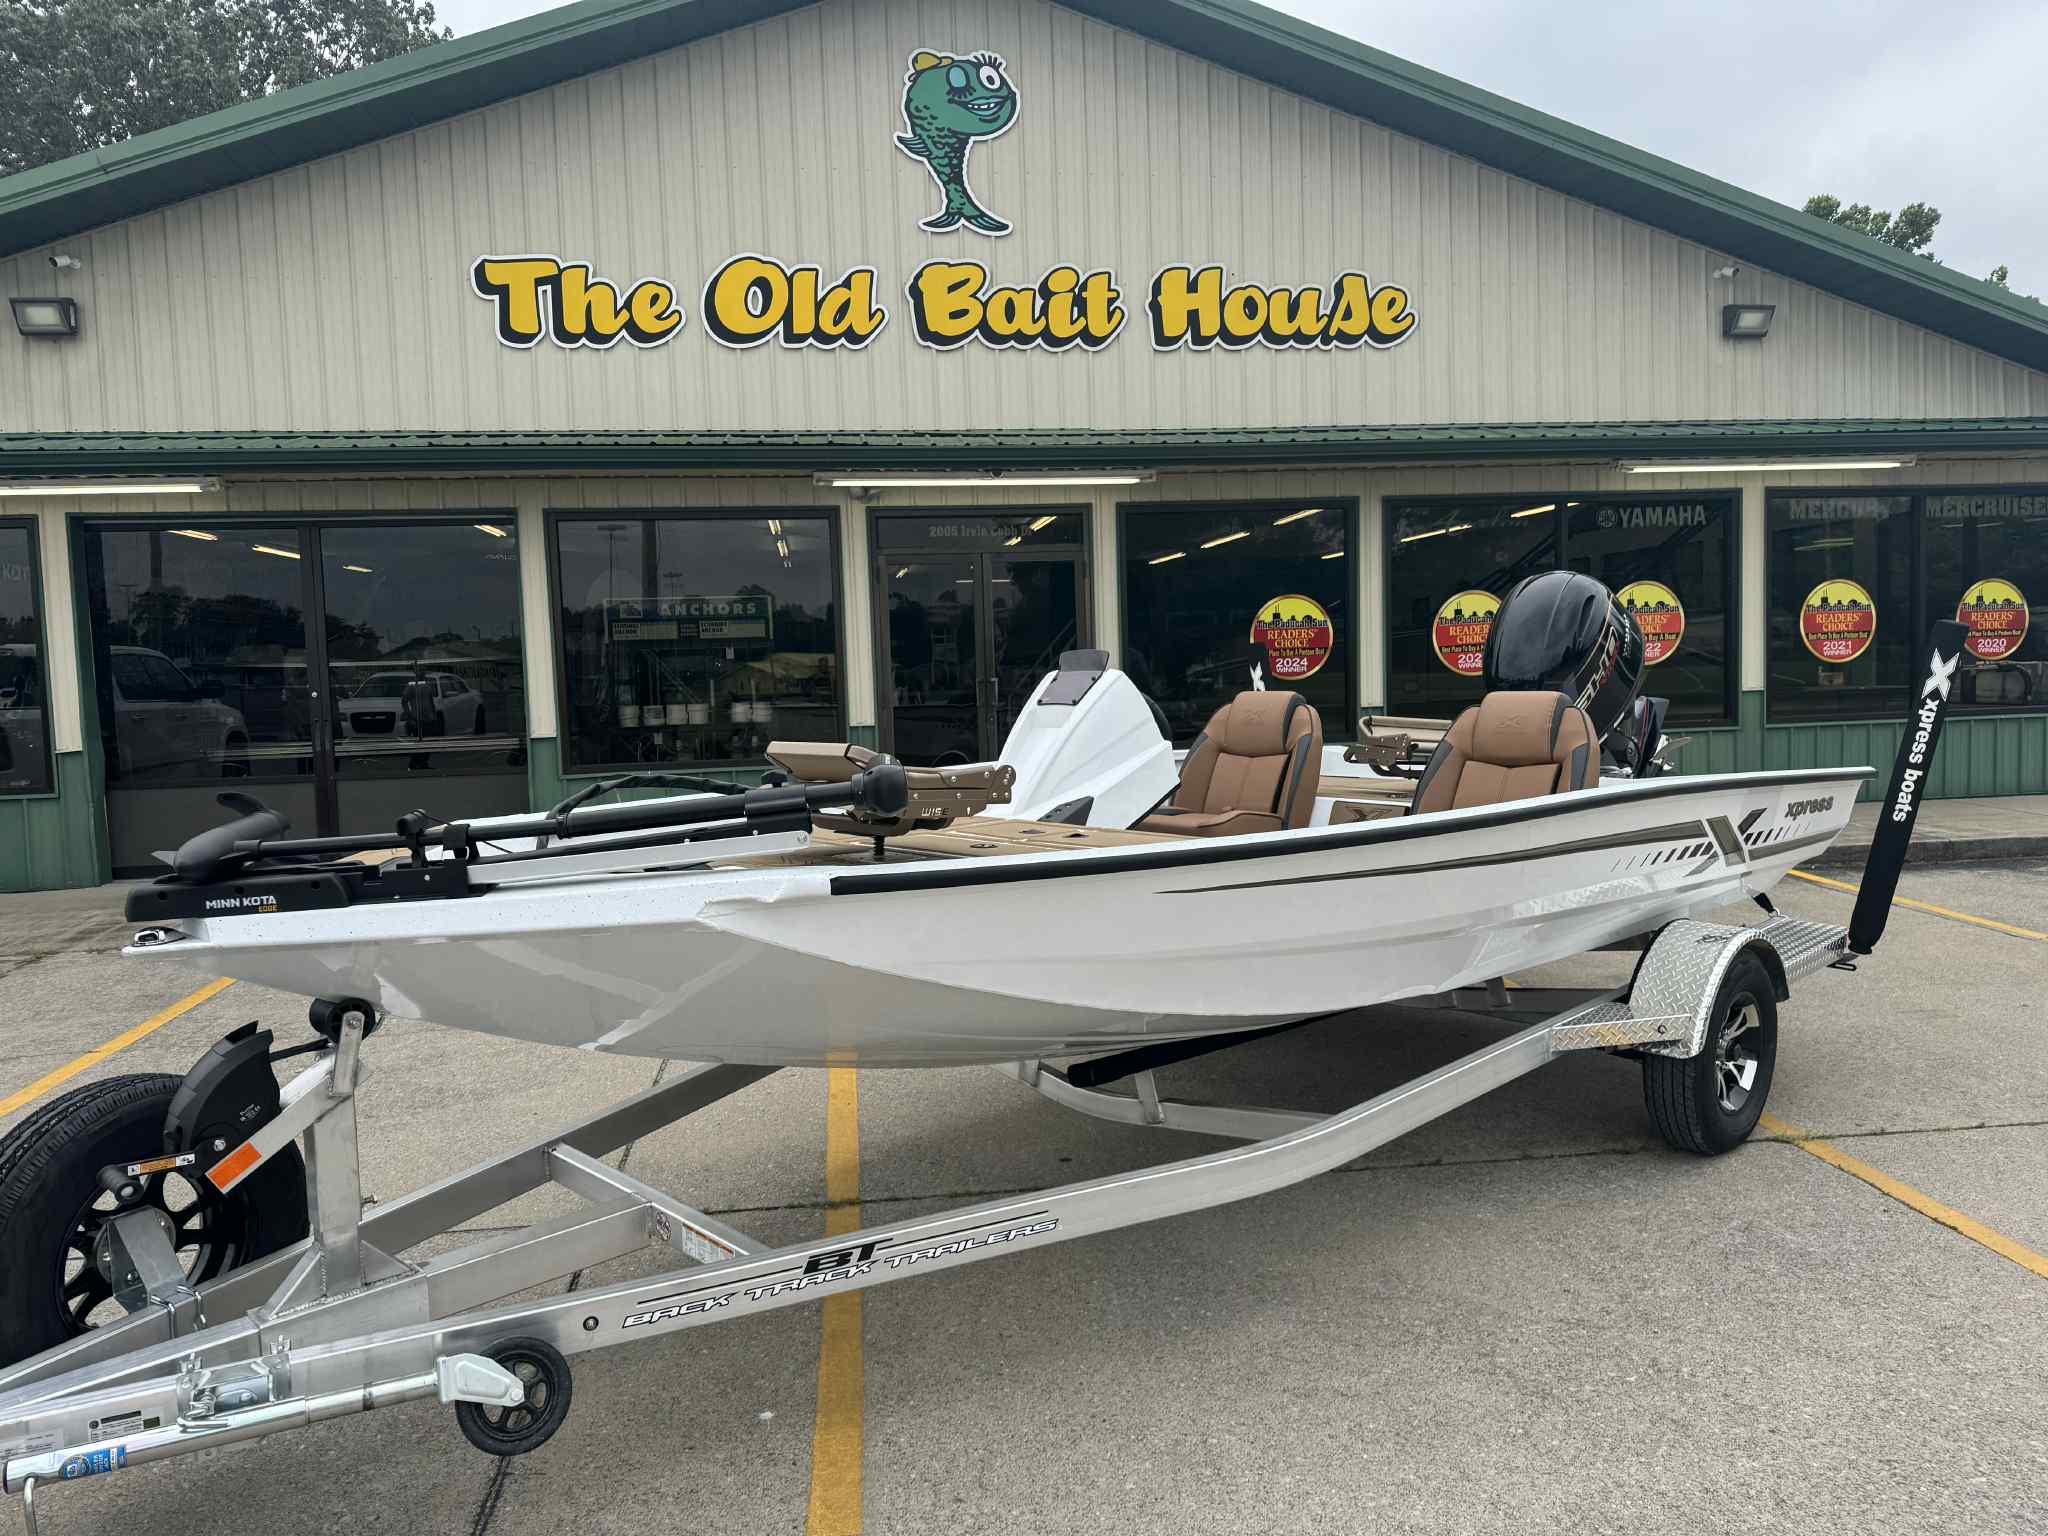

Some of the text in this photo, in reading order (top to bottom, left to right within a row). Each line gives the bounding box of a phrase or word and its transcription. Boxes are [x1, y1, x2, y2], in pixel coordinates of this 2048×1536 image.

[472, 254, 1418, 347] The Old Bait House
[1926, 495, 2048, 518] MERCRUISE
[1619, 504, 1706, 528] YAMAHA
[928, 524, 958, 538] 2005
[961, 524, 988, 537] Irvin
[660, 602, 757, 617] ANCHORS
[1449, 624, 1489, 637] READER
[1642, 624, 1662, 633] OICE
[1823, 622, 1854, 632] CHOICE
[1977, 620, 2008, 630] CHOICE
[1275, 639, 1308, 649] CHOICE
[1456, 634, 1488, 644] CHOIC
[1977, 638, 2007, 648] 2020
[1646, 642, 1662, 652] 22
[1823, 640, 1852, 650] 2021
[1823, 648, 1852, 656] WINNER
[1275, 657, 1309, 668] 2024
[1457, 653, 1482, 664] 202
[1276, 665, 1308, 673] WINNER
[1892, 697, 1940, 823] xpress boats
[921, 807, 950, 817] WISE
[1784, 795, 1834, 822] xpress
[205, 895, 277, 909] MINN KOTA
[258, 904, 278, 913] EDGE
[801, 1238, 893, 1276] BT
[622, 1218, 1060, 1329] BACK TRACK TRAILERS
